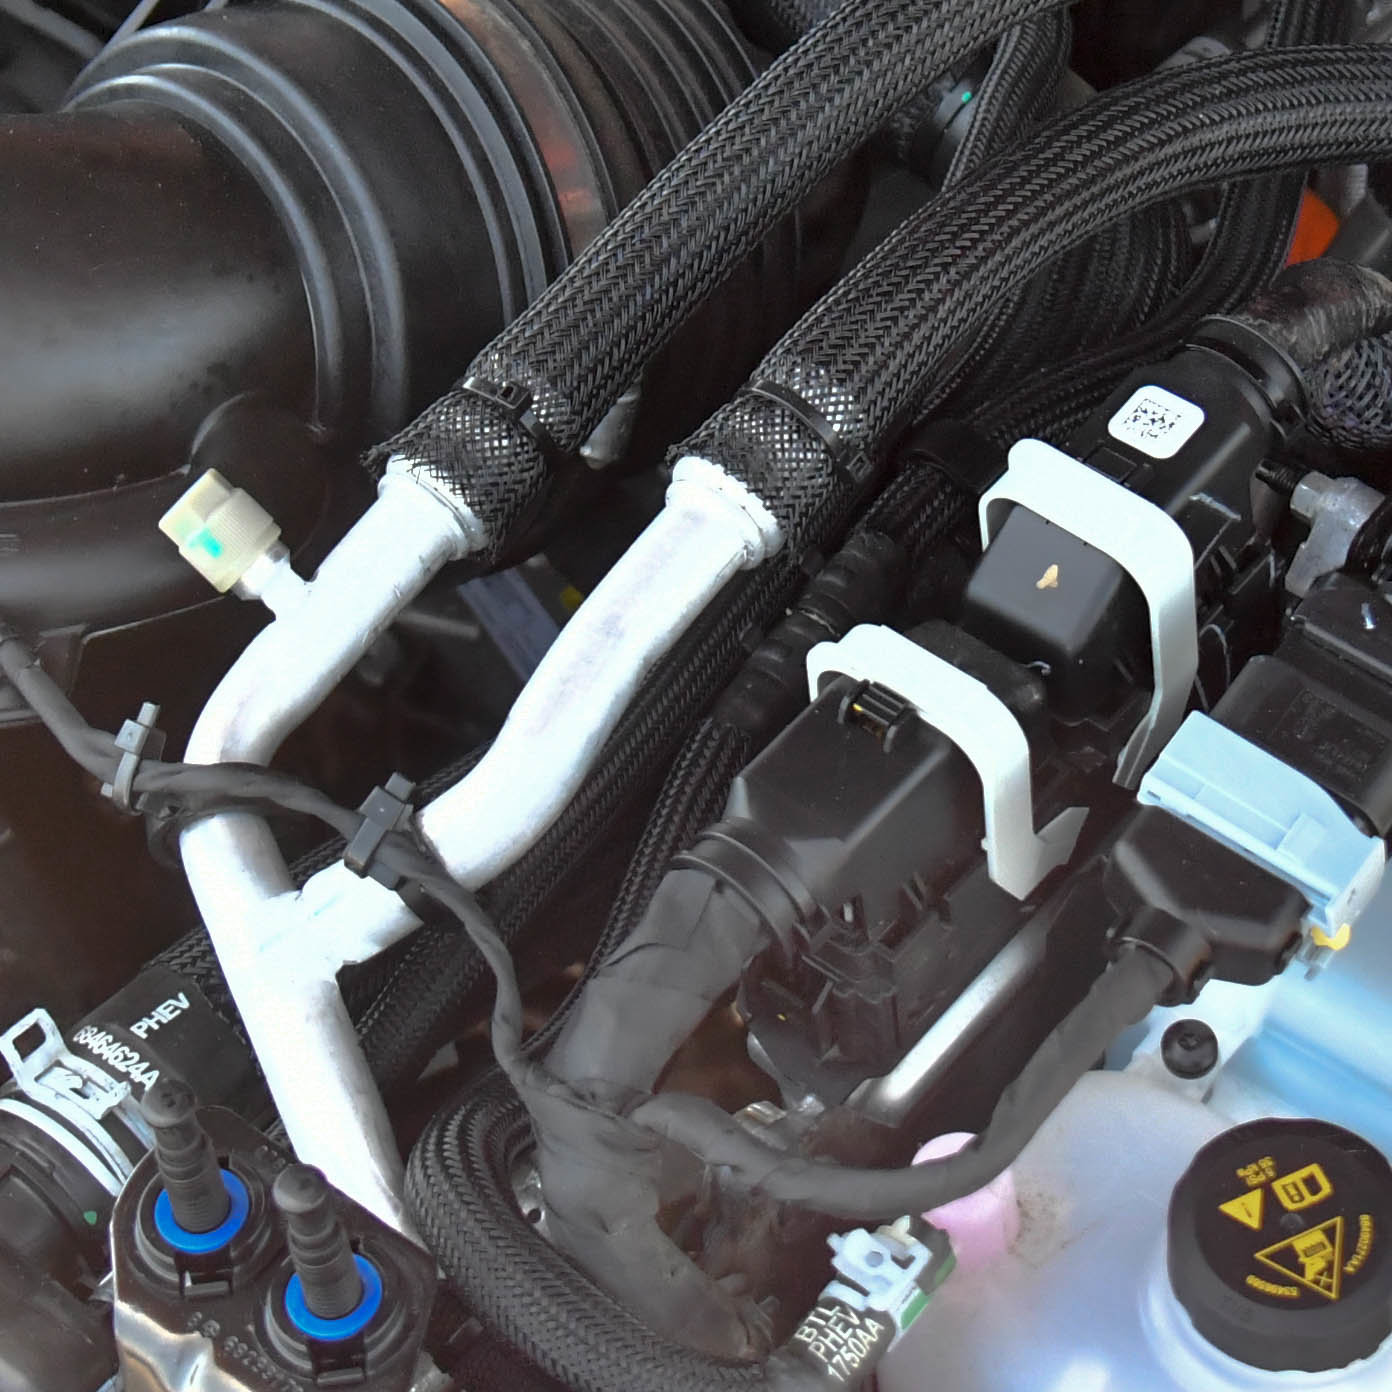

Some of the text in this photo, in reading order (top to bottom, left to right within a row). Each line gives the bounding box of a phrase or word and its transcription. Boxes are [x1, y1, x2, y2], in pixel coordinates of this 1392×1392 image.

[130, 991, 190, 1039] PHEV
[795, 1304, 839, 1342] BTL
[809, 1307, 861, 1362] PHEV
[827, 1319, 884, 1383] 1750AA
